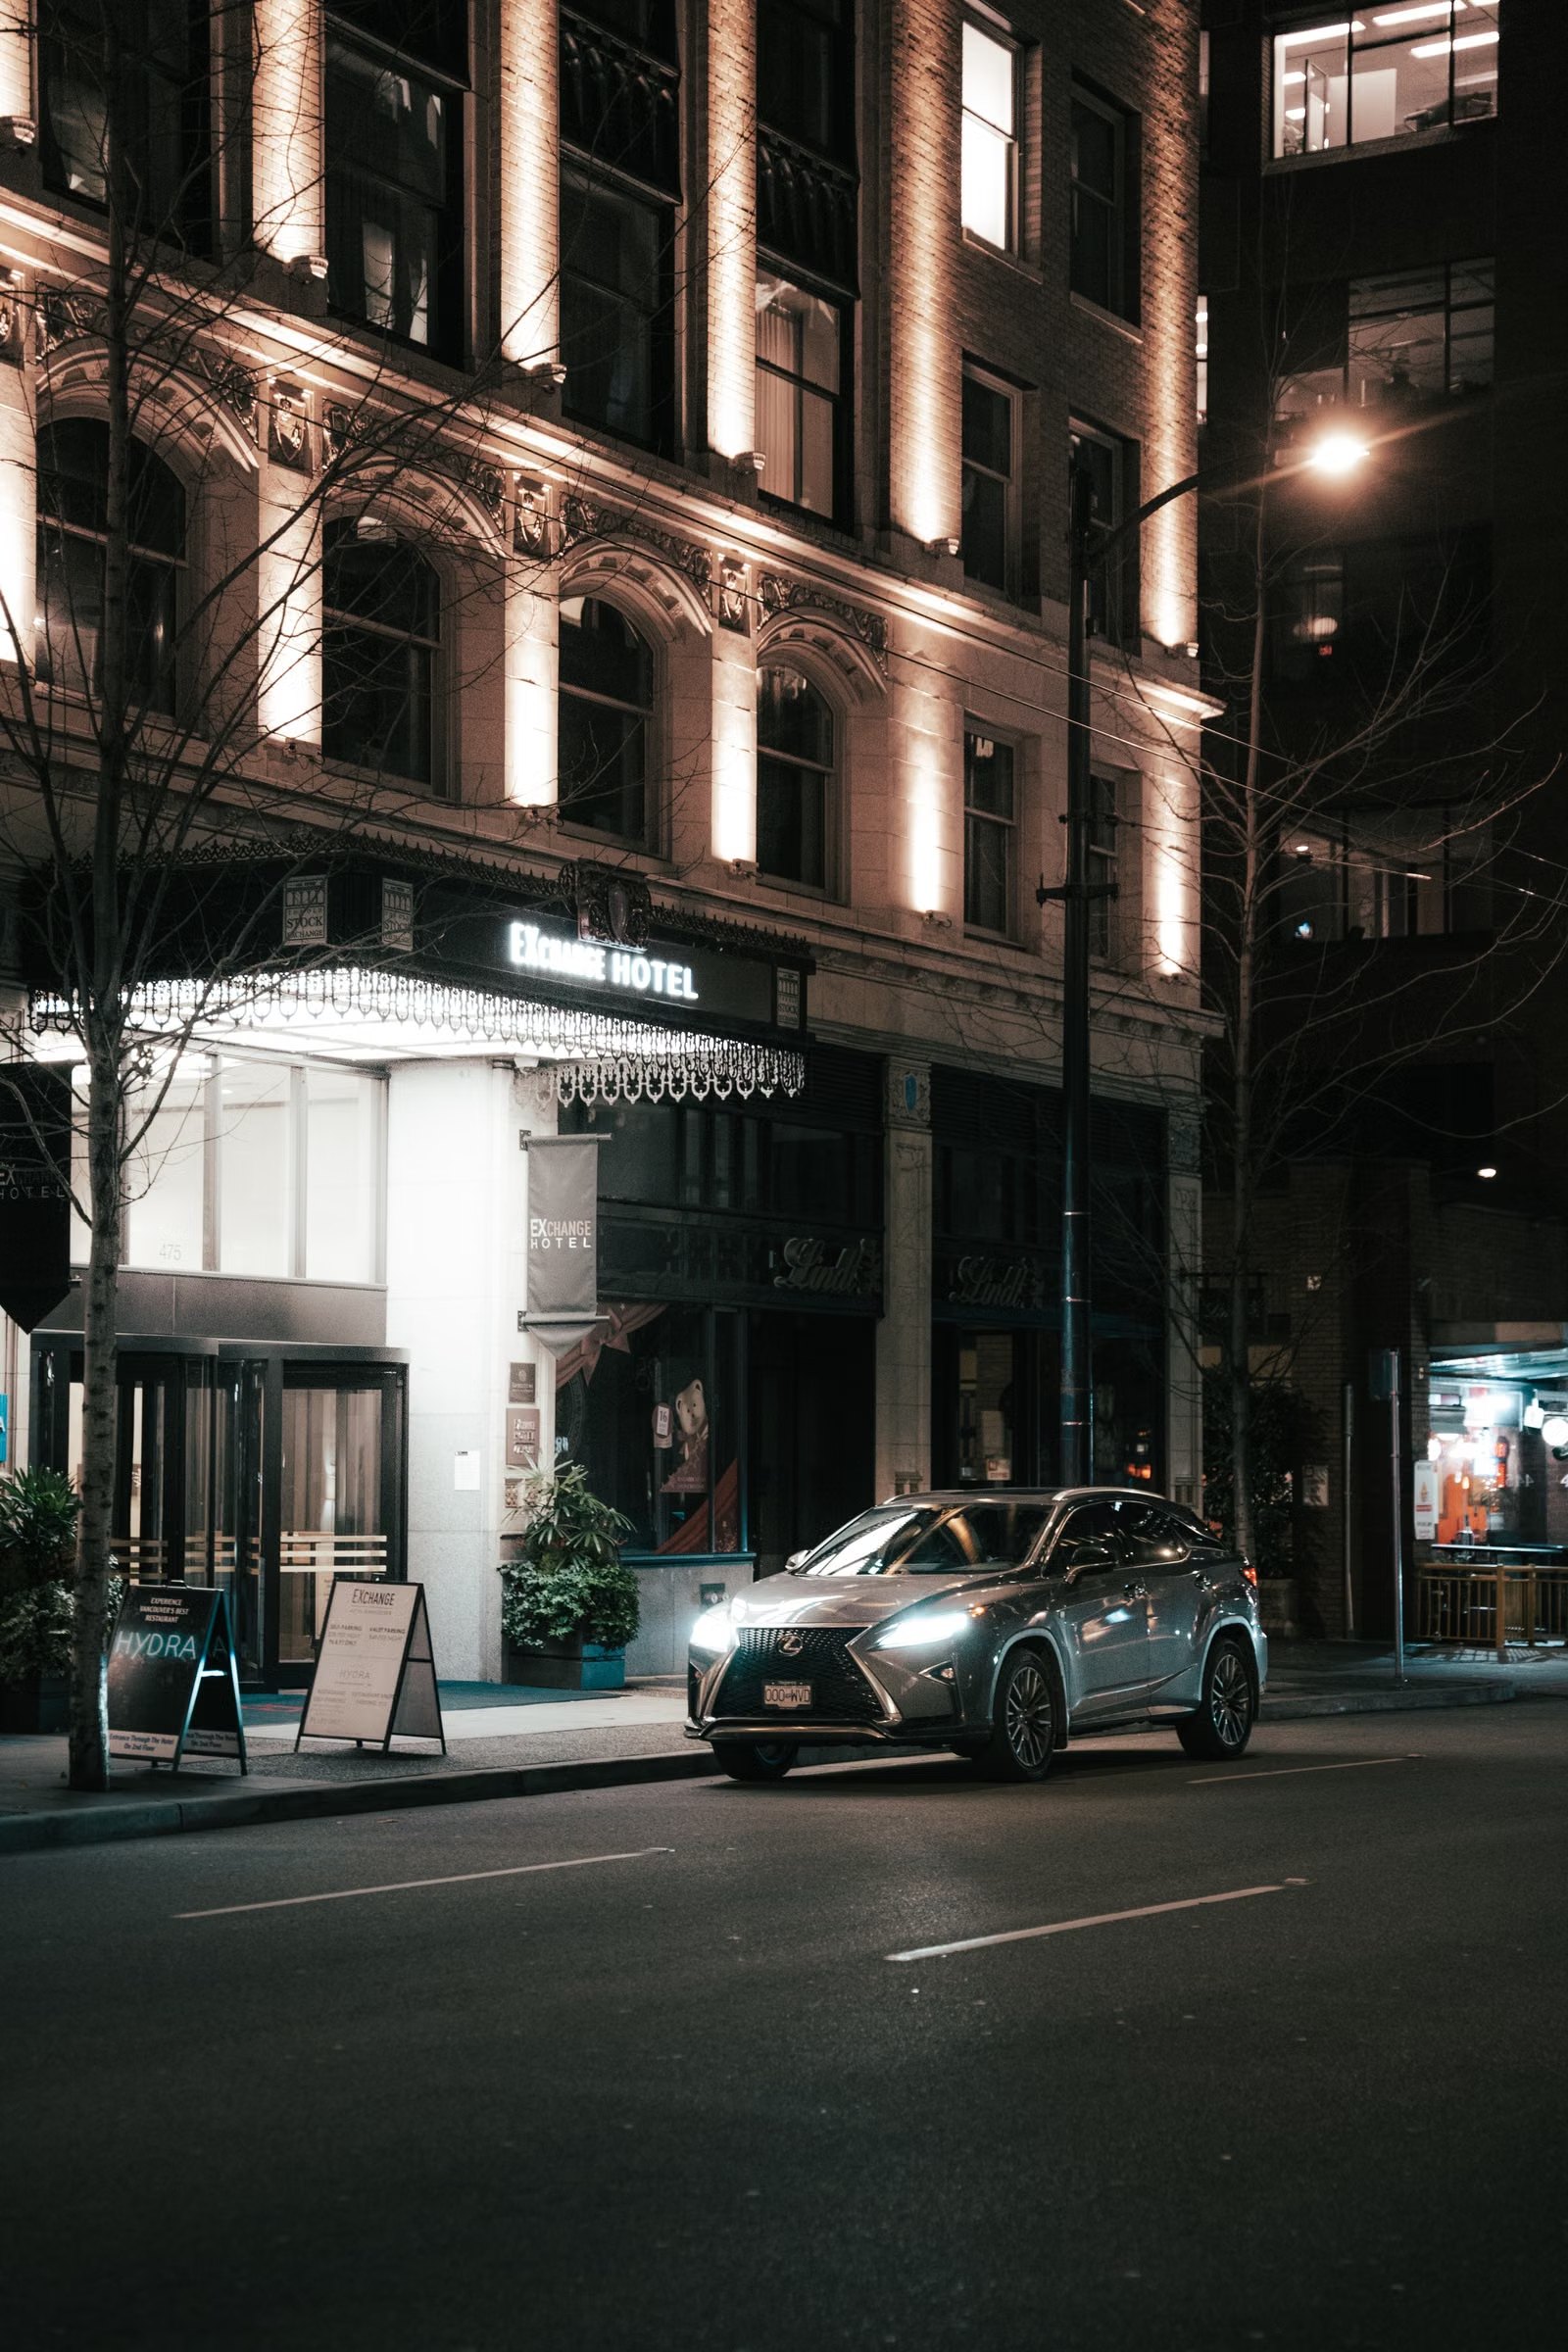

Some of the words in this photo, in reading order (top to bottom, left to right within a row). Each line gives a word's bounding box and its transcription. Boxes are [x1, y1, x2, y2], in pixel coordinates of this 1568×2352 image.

[287, 916, 322, 928] STOCK
[510, 921, 606, 981] EXCHANGE
[612, 952, 699, 1000] HOTEL
[530, 1218, 591, 1238] EXCHANGE
[530, 1238, 592, 1250] HOTEL
[159, 1244, 181, 1260] 475
[150, 1597, 182, 1606] EXPERIENCE
[352, 1589, 395, 1605] EXCHANGE
[140, 1605, 174, 1614] VANCOUVER'S
[115, 1631, 197, 1661] HYDRA
[339, 1670, 371, 1680] HYDRA
[130, 1734, 151, 1743] Through
[142, 1743, 156, 1752] Floor
